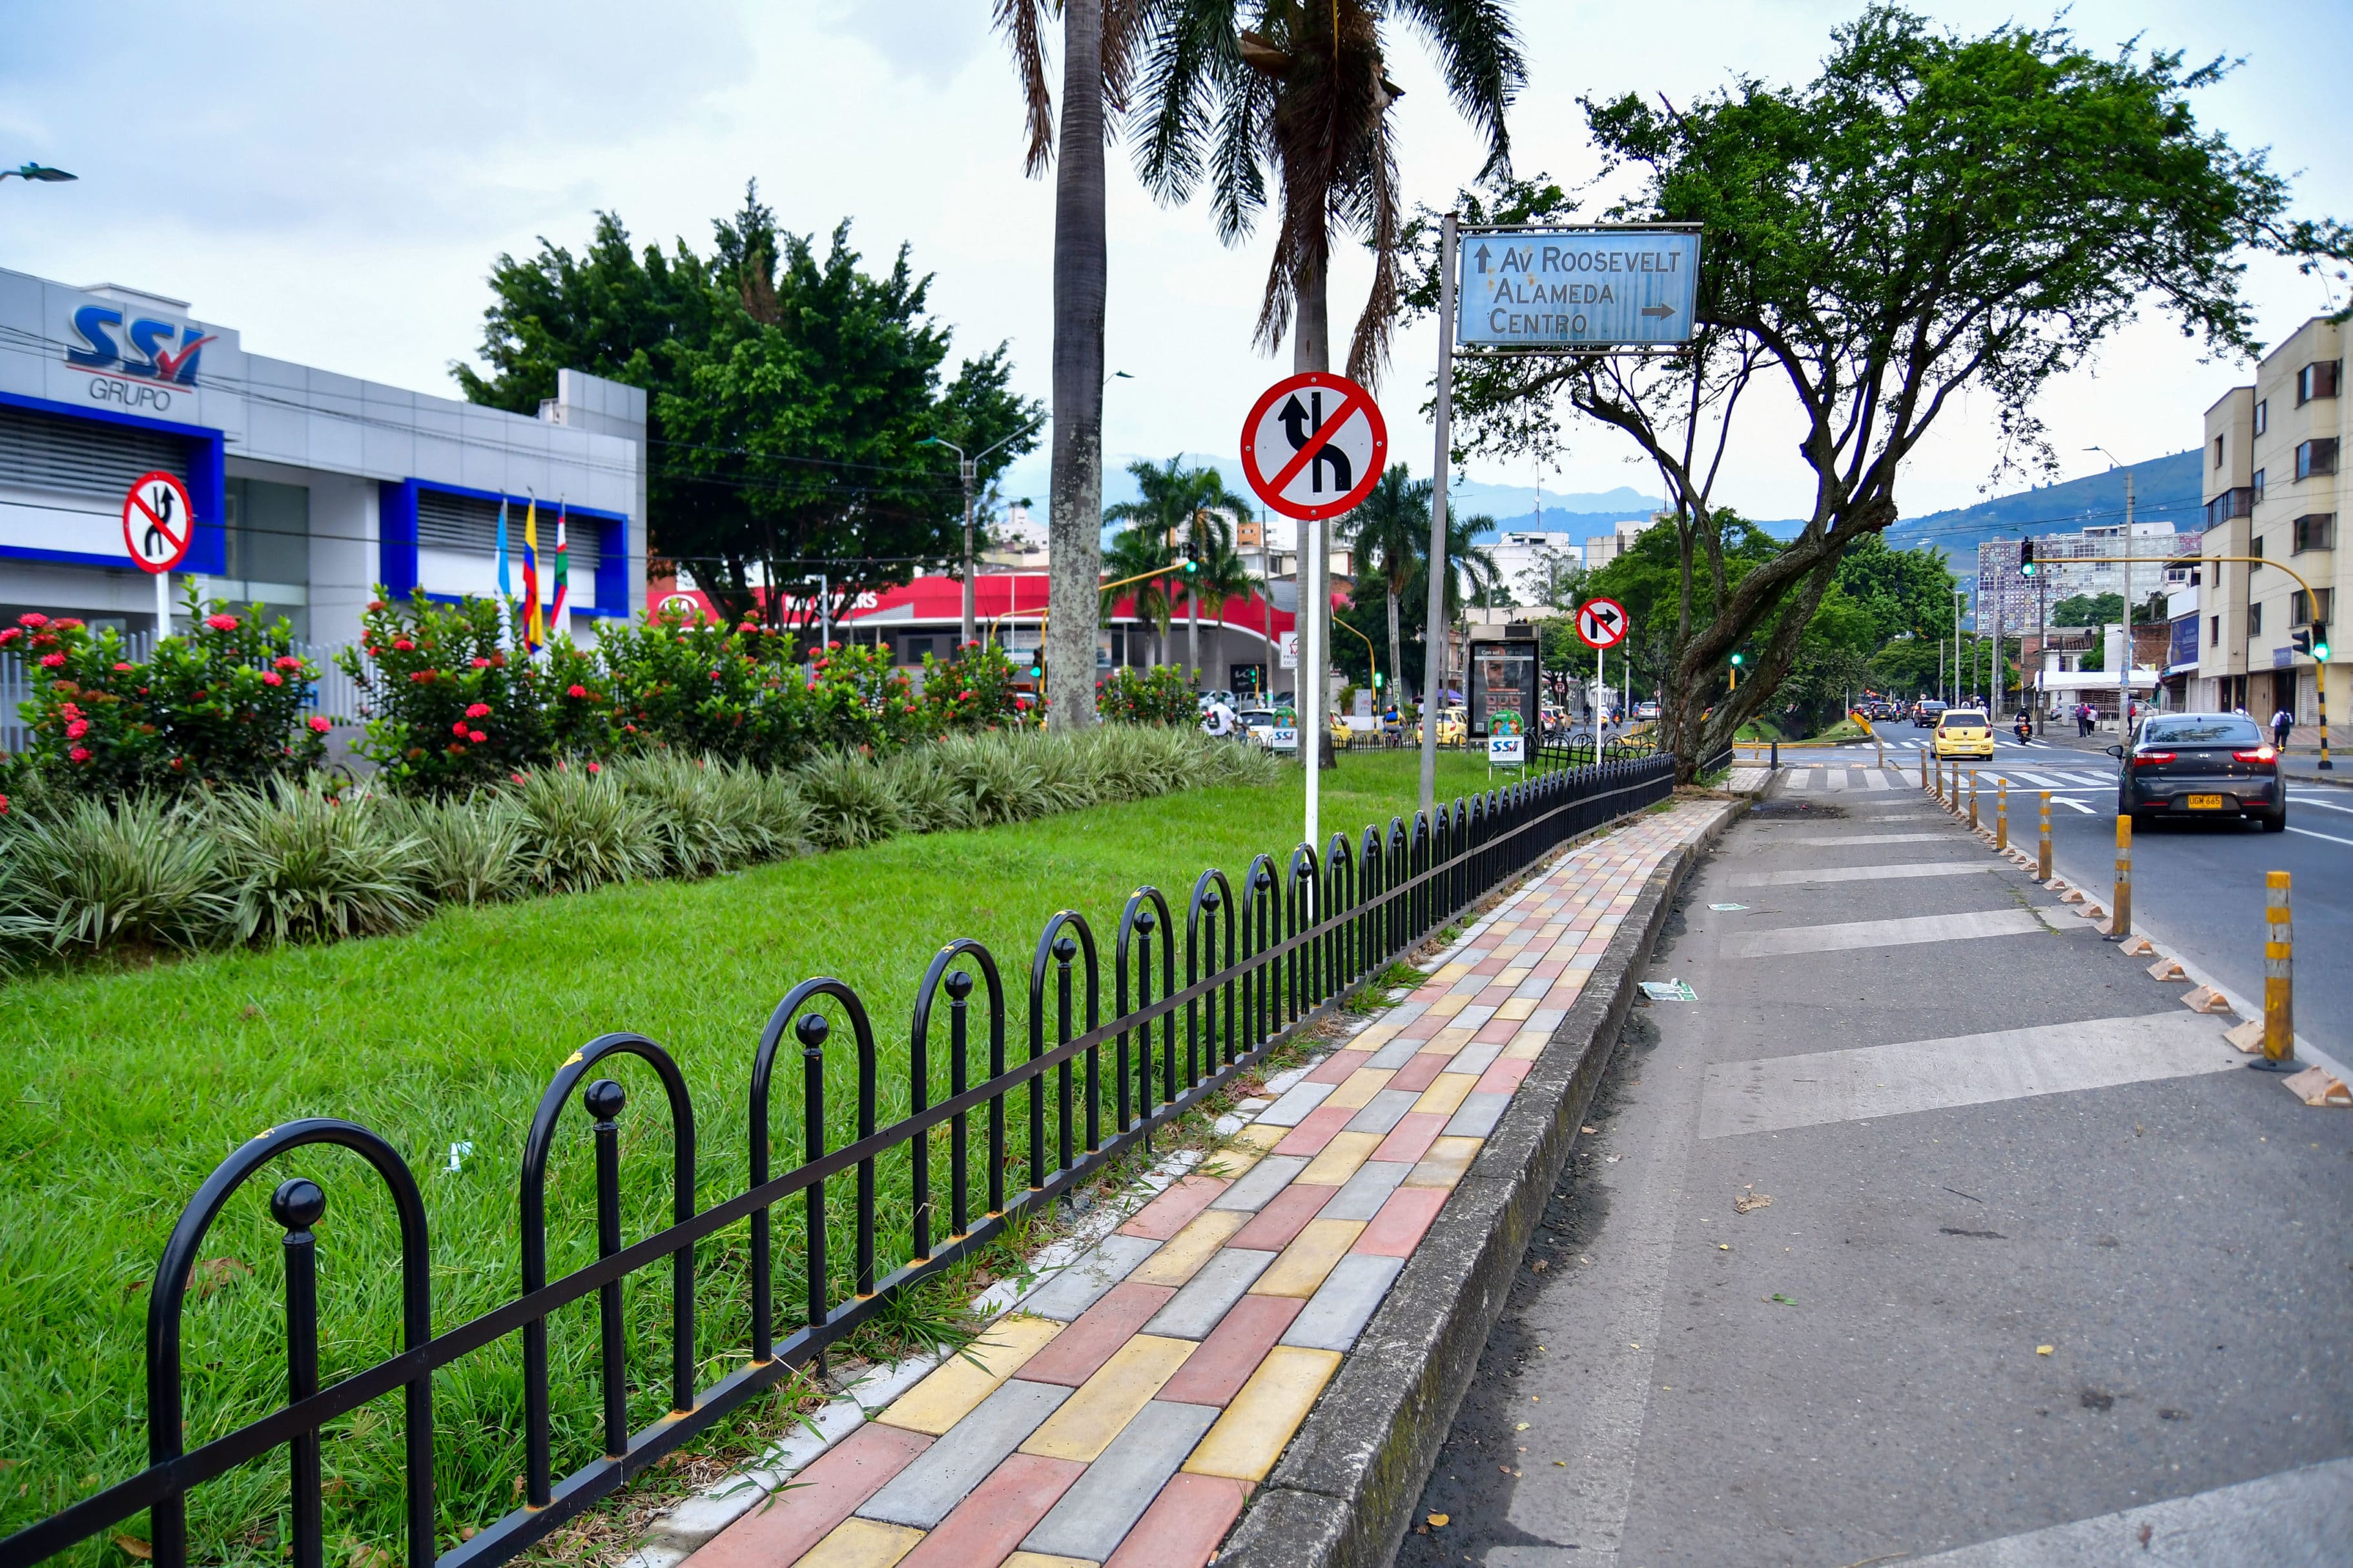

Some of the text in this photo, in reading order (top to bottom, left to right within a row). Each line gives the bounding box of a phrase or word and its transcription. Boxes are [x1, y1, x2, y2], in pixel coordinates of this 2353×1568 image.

[1542, 247, 1681, 273] ROOSEVELT
[1493, 278, 1614, 304] ALAMEDA
[1489, 308, 1588, 334] CENTRO
[89, 378, 171, 412] GRUPO
[2189, 795, 2220, 804] UGM 665
